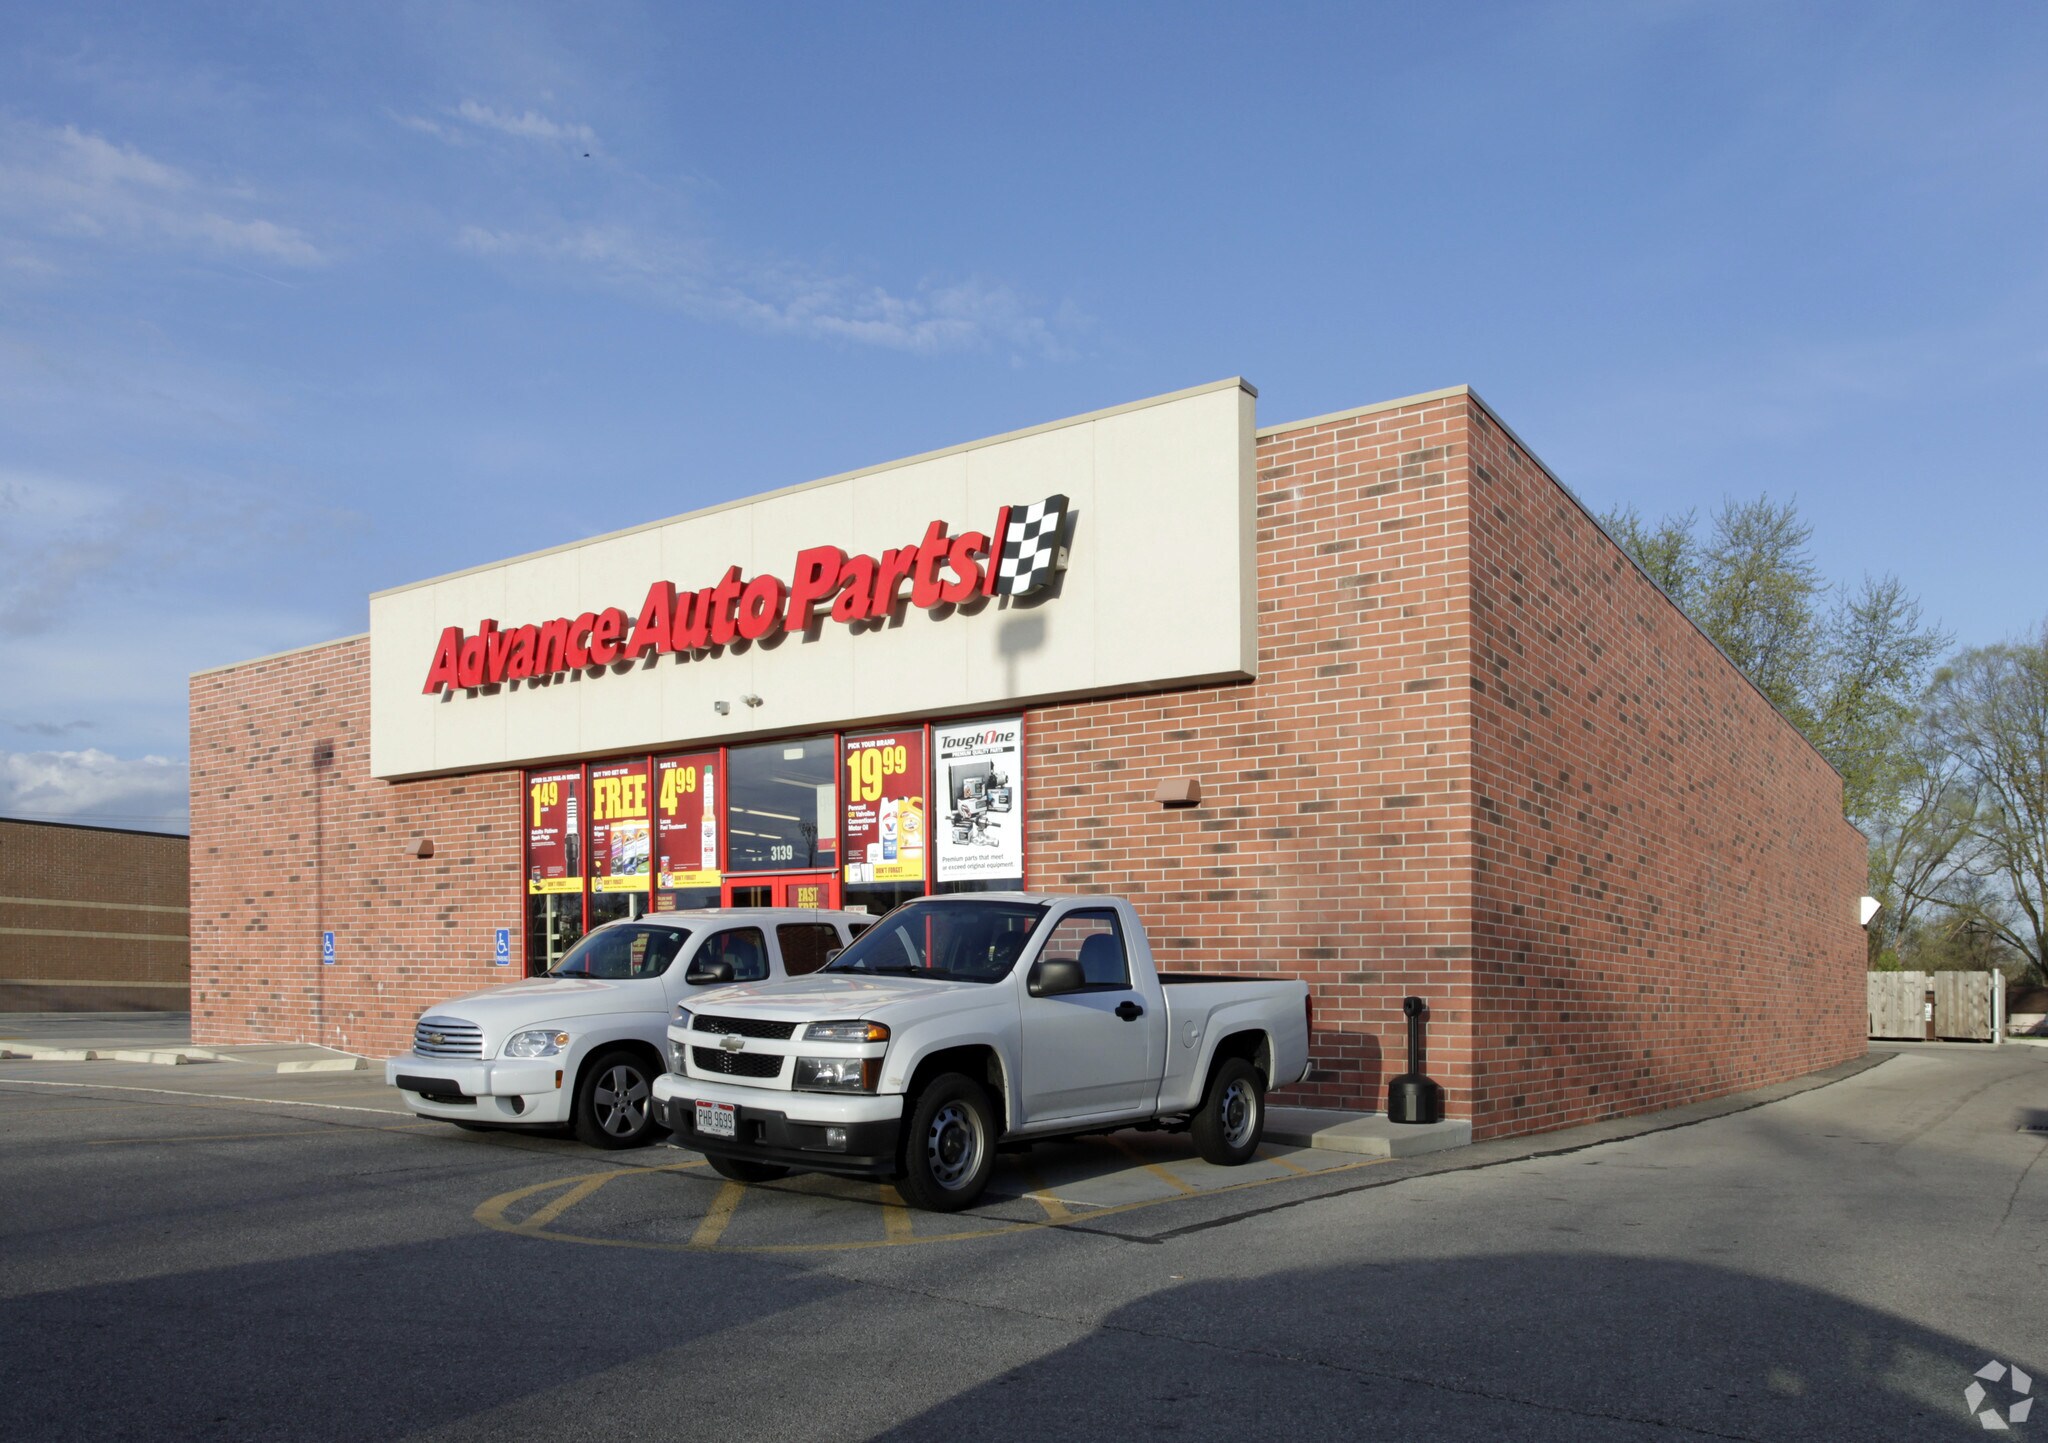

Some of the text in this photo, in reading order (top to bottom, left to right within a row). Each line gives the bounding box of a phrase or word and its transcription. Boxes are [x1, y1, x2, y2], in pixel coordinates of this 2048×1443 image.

[422, 519, 990, 694] Advance Auto Parts
[861, 740, 876, 748] YOUR
[876, 738, 896, 746] BRAND
[952, 750, 971, 758] PREMIUM
[593, 774, 647, 820] FREE
[770, 845, 793, 861] 3139
[798, 887, 819, 902] FAST
[698, 1108, 732, 1129] PHB 9699
